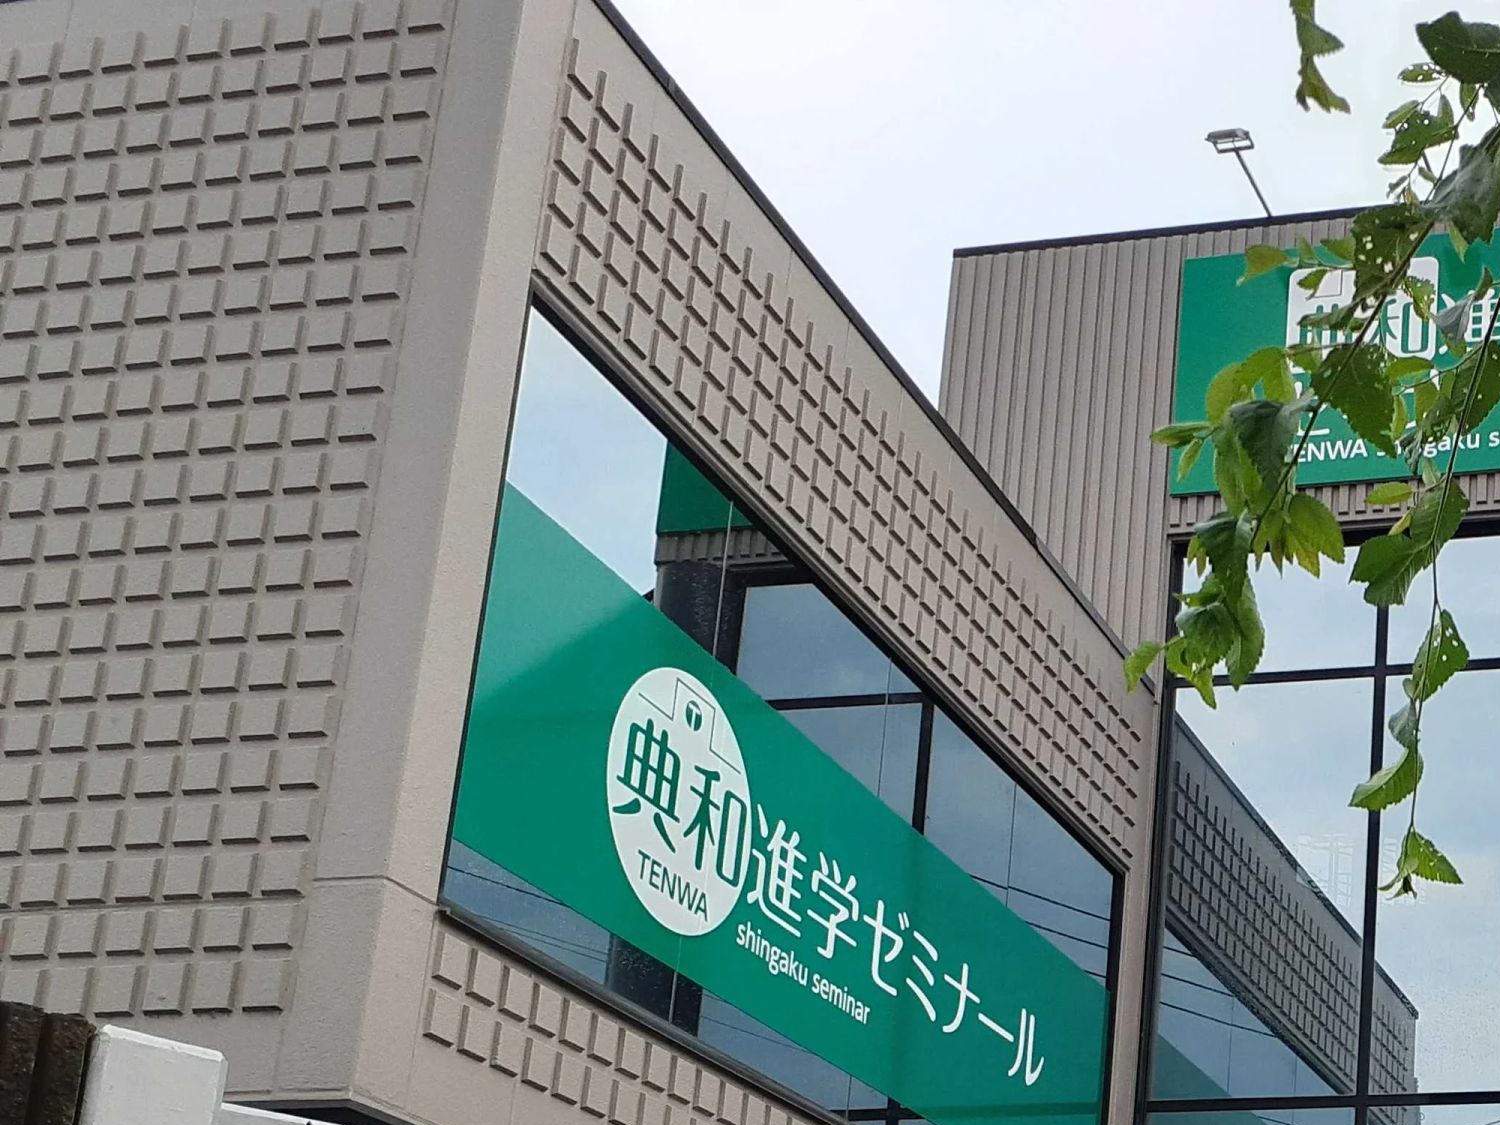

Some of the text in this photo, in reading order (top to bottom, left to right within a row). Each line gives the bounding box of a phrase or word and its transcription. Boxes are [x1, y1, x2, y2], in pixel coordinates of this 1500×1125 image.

[637, 849, 871, 1025] TENWA shingaku seminar
